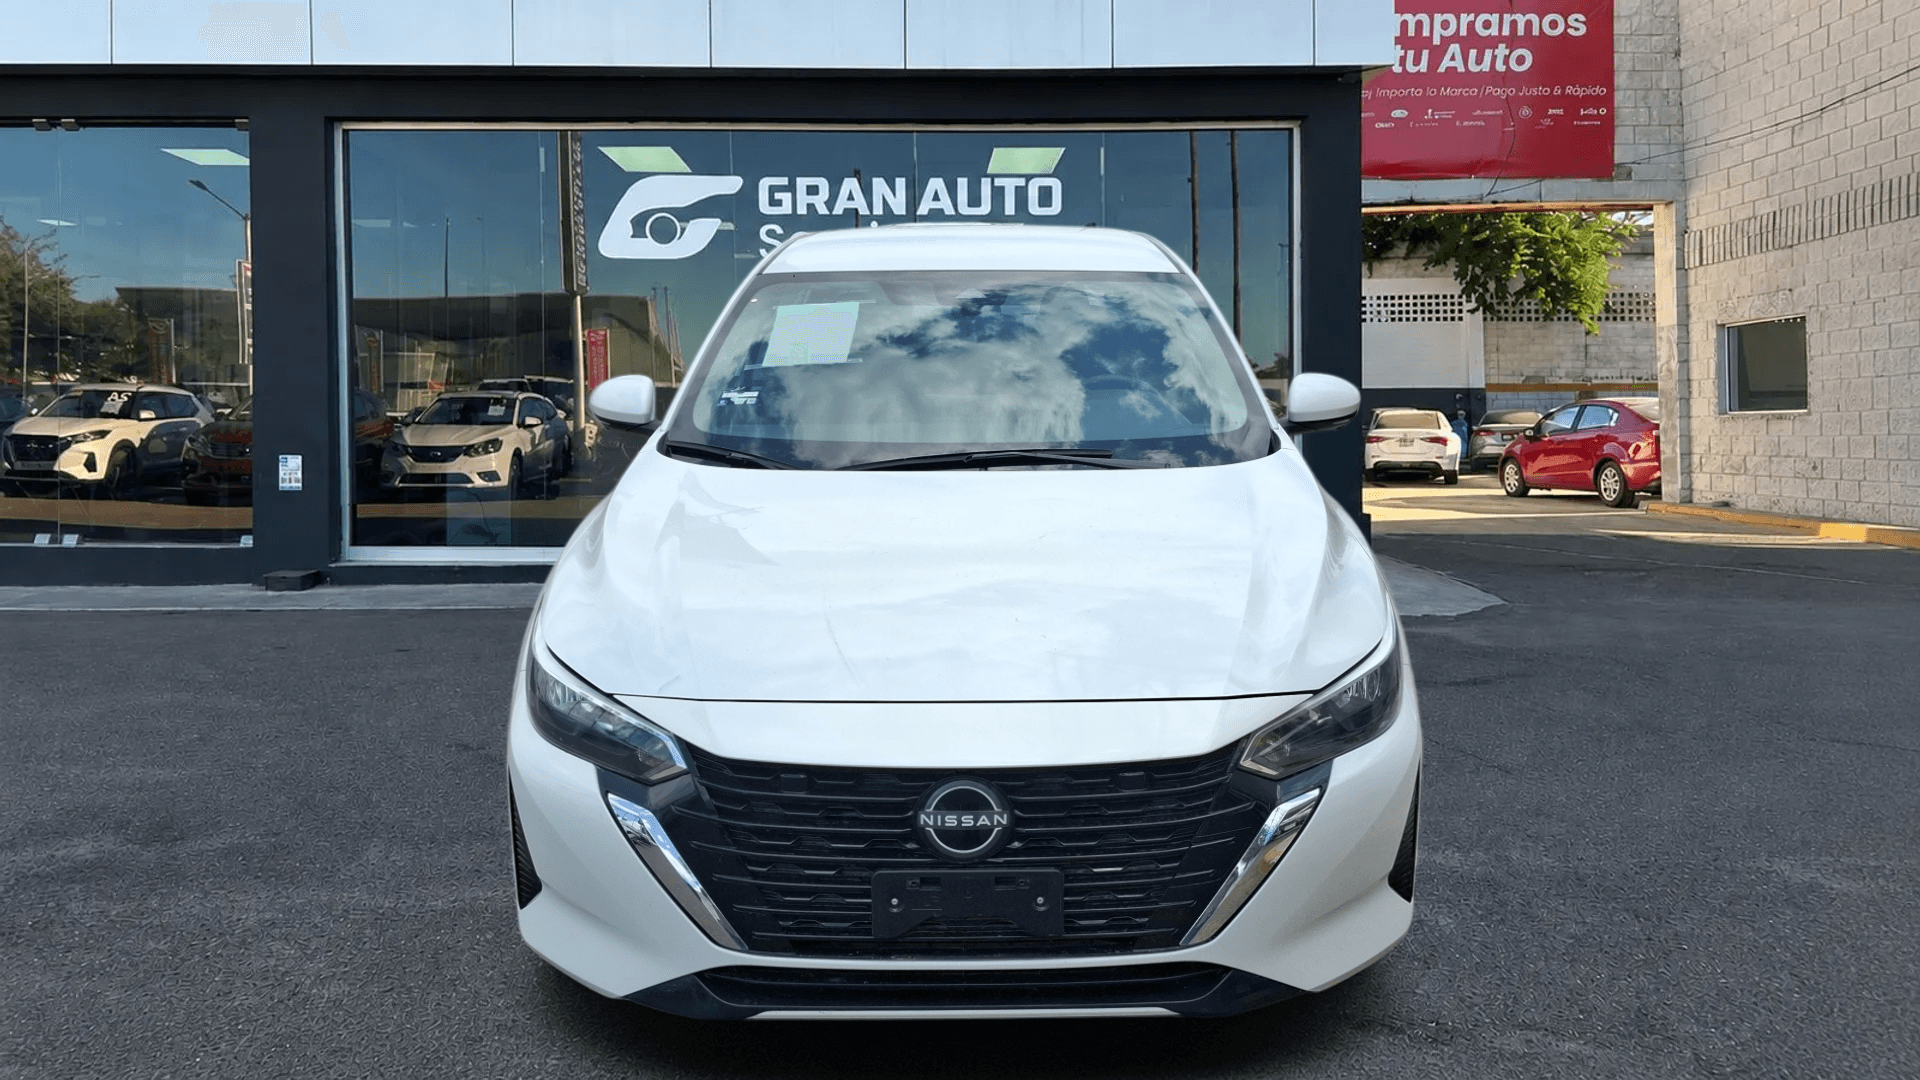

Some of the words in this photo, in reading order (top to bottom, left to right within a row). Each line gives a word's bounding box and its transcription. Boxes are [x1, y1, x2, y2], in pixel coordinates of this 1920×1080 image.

[1395, 12, 1588, 46] mpramos
[1392, 44, 1430, 73] tu
[1437, 43, 1533, 73] Auto
[1376, 88, 1423, 99] Importa
[1426, 86, 1437, 97] la
[1439, 86, 1478, 97] Marca
[1518, 86, 1551, 96] Justo
[1552, 86, 1561, 96] &
[758, 176, 906, 216] GRAN
[916, 176, 1063, 216] AUTO
[920, 813, 1007, 827] NISSAN
